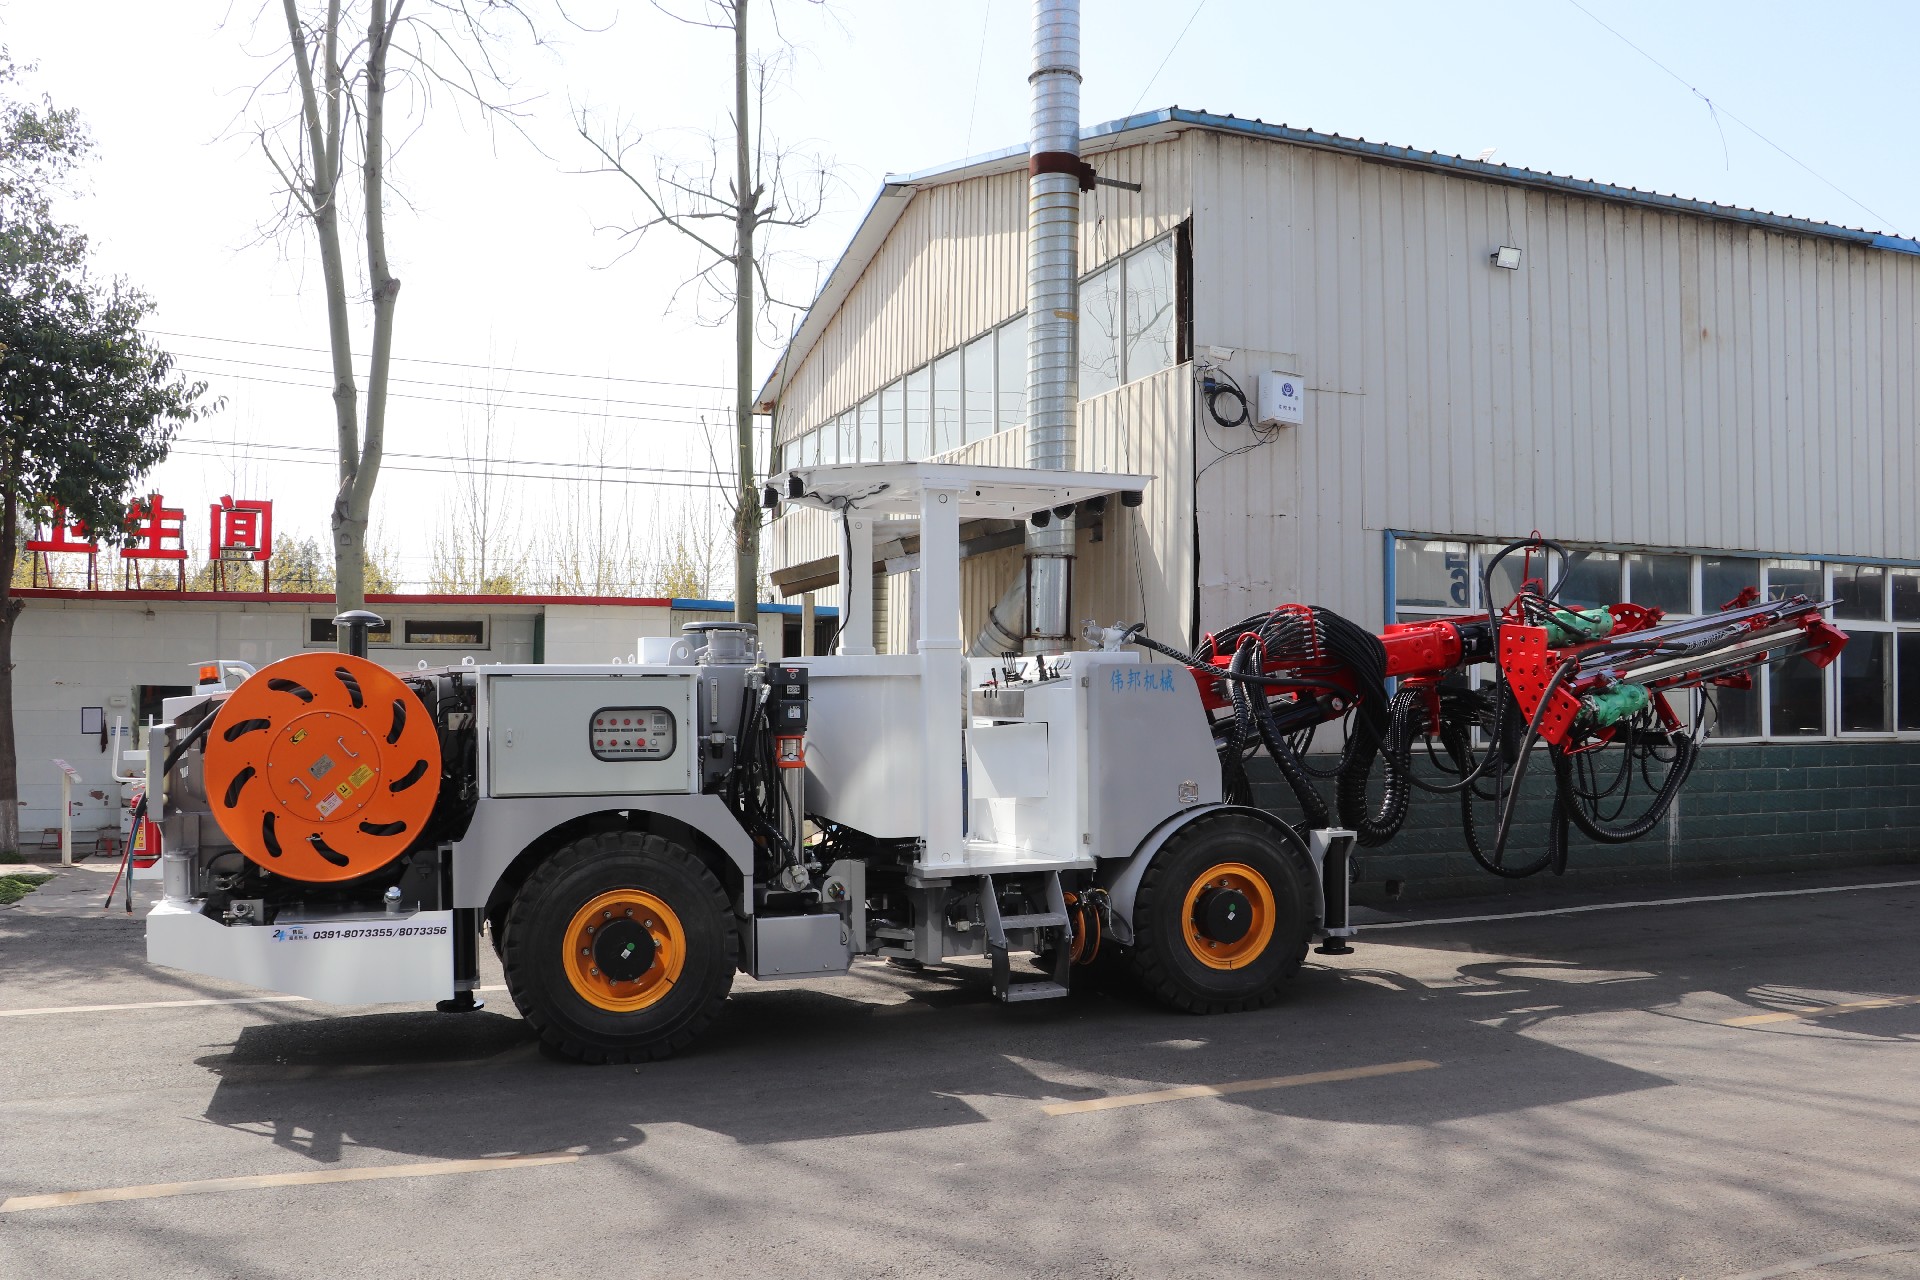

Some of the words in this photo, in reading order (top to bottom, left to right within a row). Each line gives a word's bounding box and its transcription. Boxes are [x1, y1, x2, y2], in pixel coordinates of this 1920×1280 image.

[1111, 668, 1175, 692] 伟邦机械
[313, 926, 447, 939] 0391-8073355/8073356
